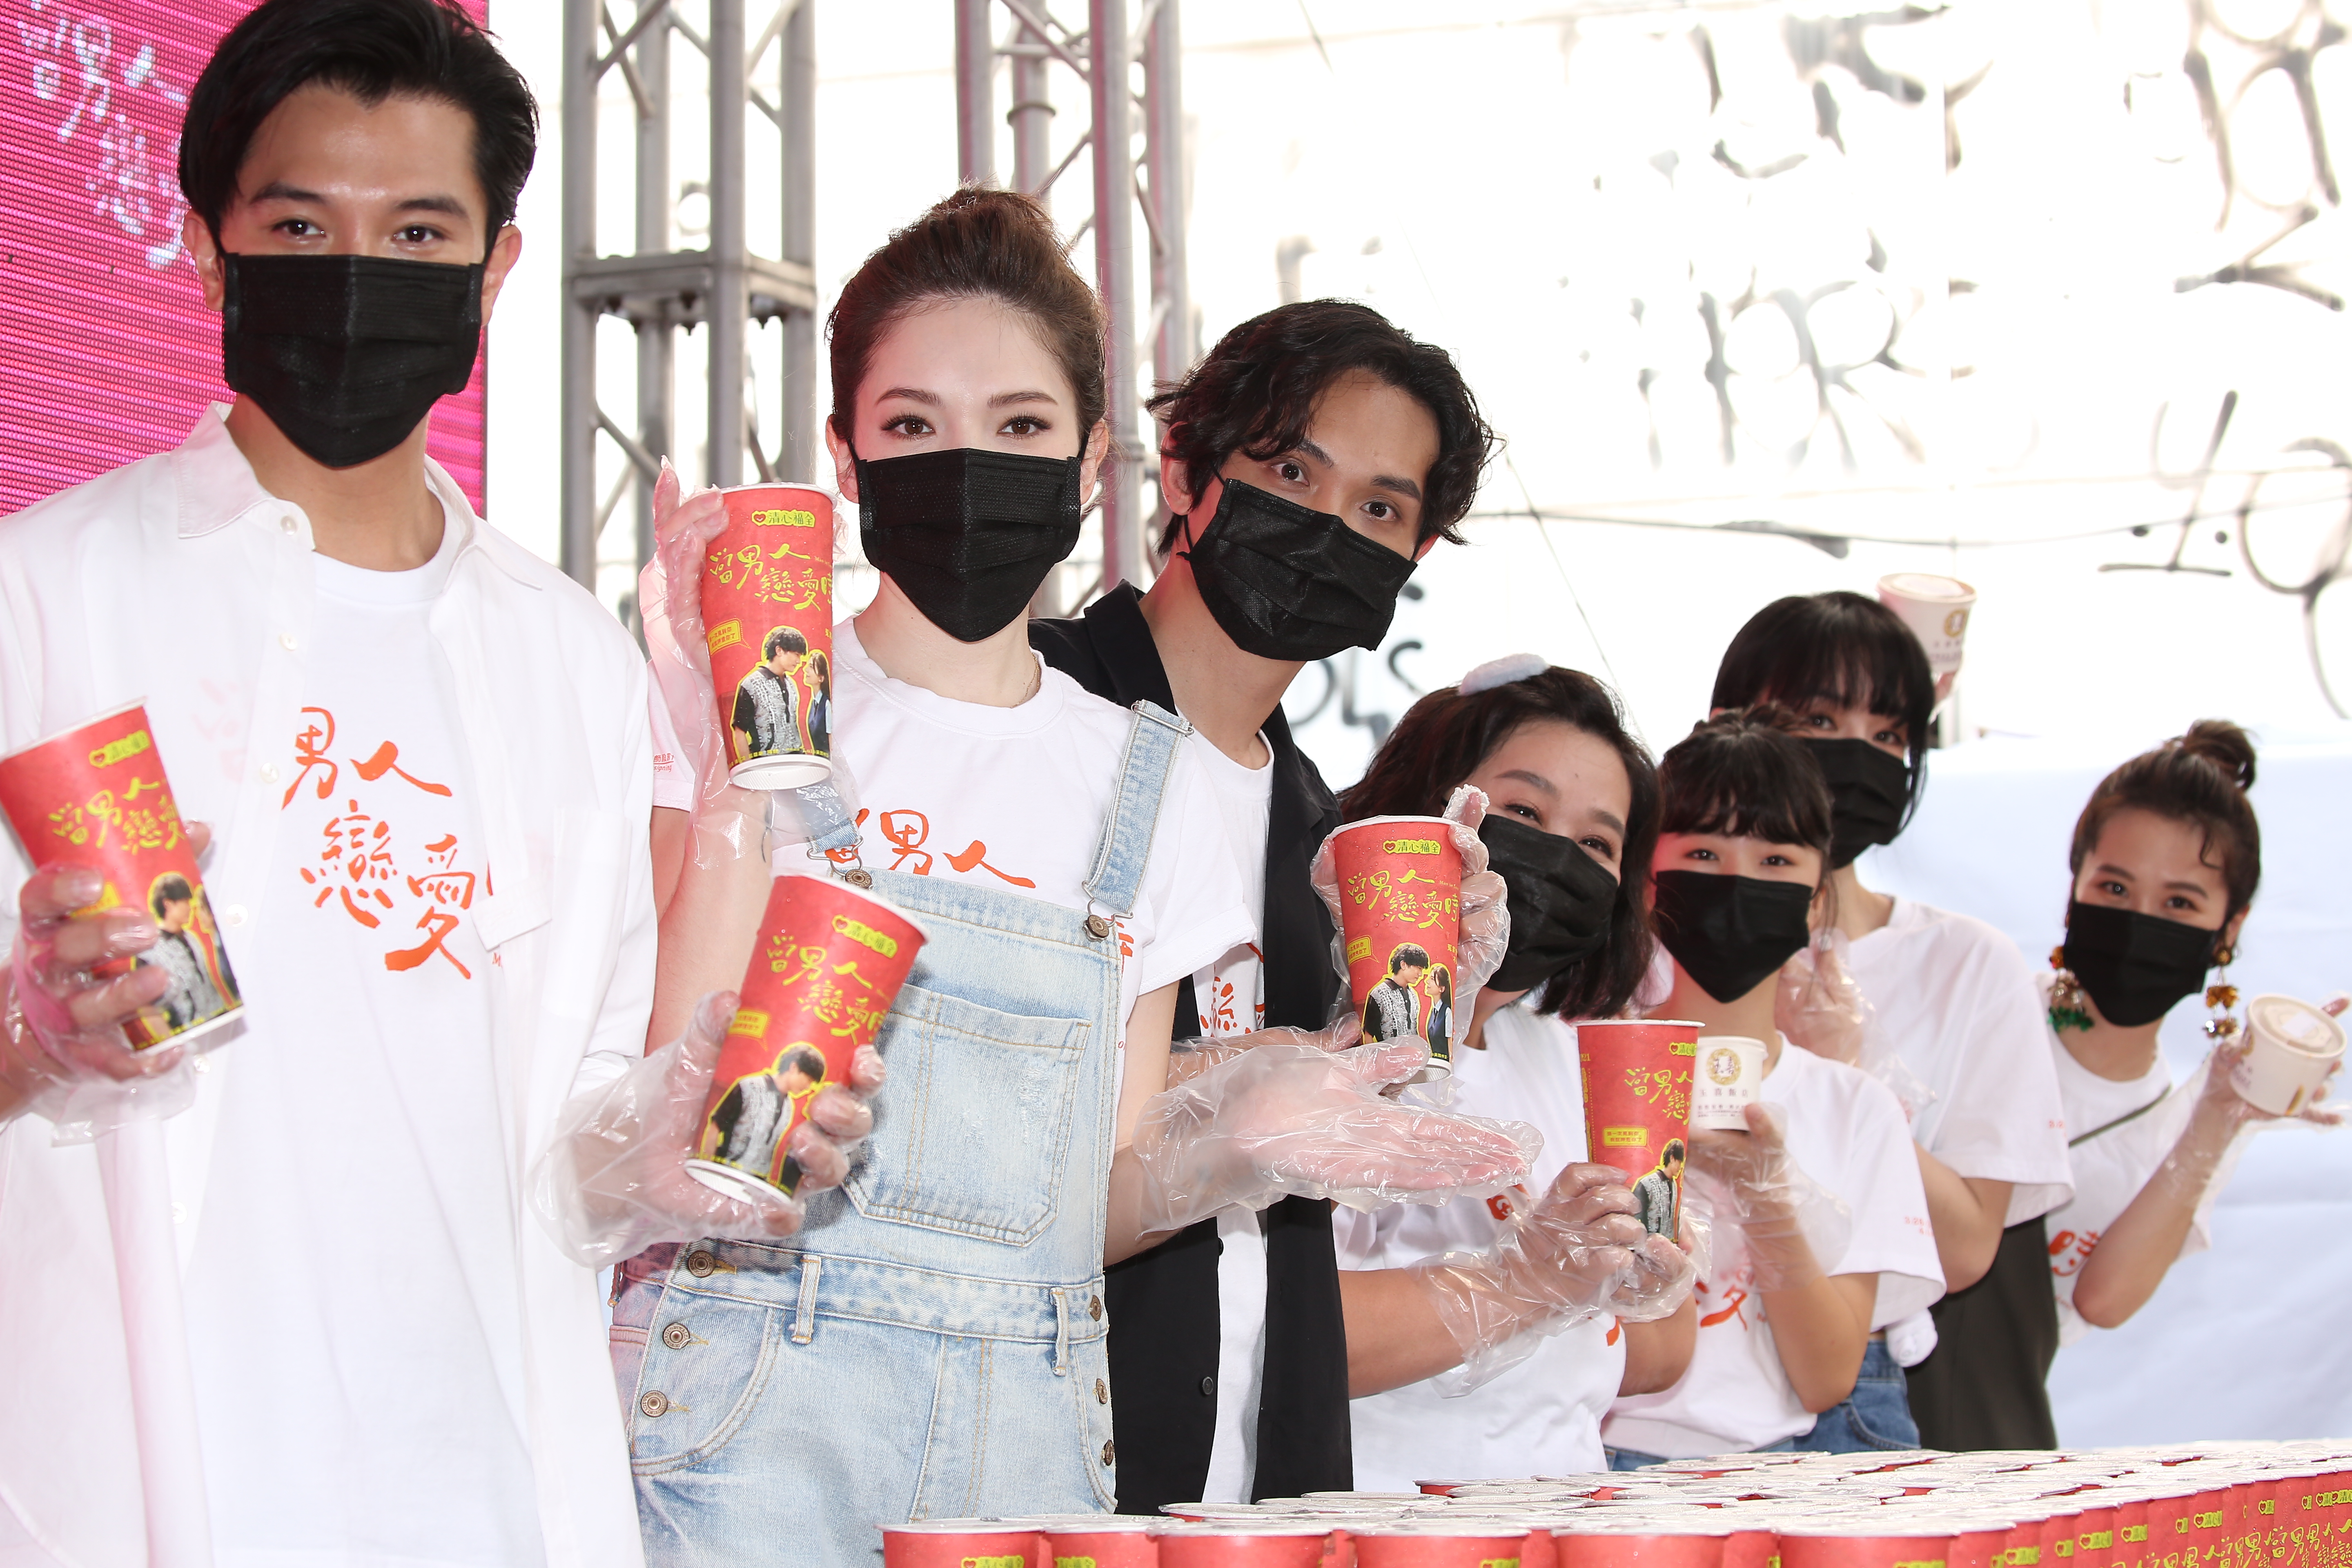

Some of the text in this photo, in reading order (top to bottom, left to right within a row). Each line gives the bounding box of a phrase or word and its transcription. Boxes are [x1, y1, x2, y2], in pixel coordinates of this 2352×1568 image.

[768, 512, 814, 526] 清心福全
[709, 543, 810, 589] 當男人
[281, 706, 452, 811] 男人
[825, 808, 1036, 888] 男人
[1398, 840, 1439, 853] 清心福全
[300, 799, 475, 980] 戀愛
[1348, 870, 1435, 910] 當男人
[1383, 891, 1459, 929] 戀愛時
[766, 934, 873, 989] 當男人
[1624, 1067, 1693, 1104] 當男人
